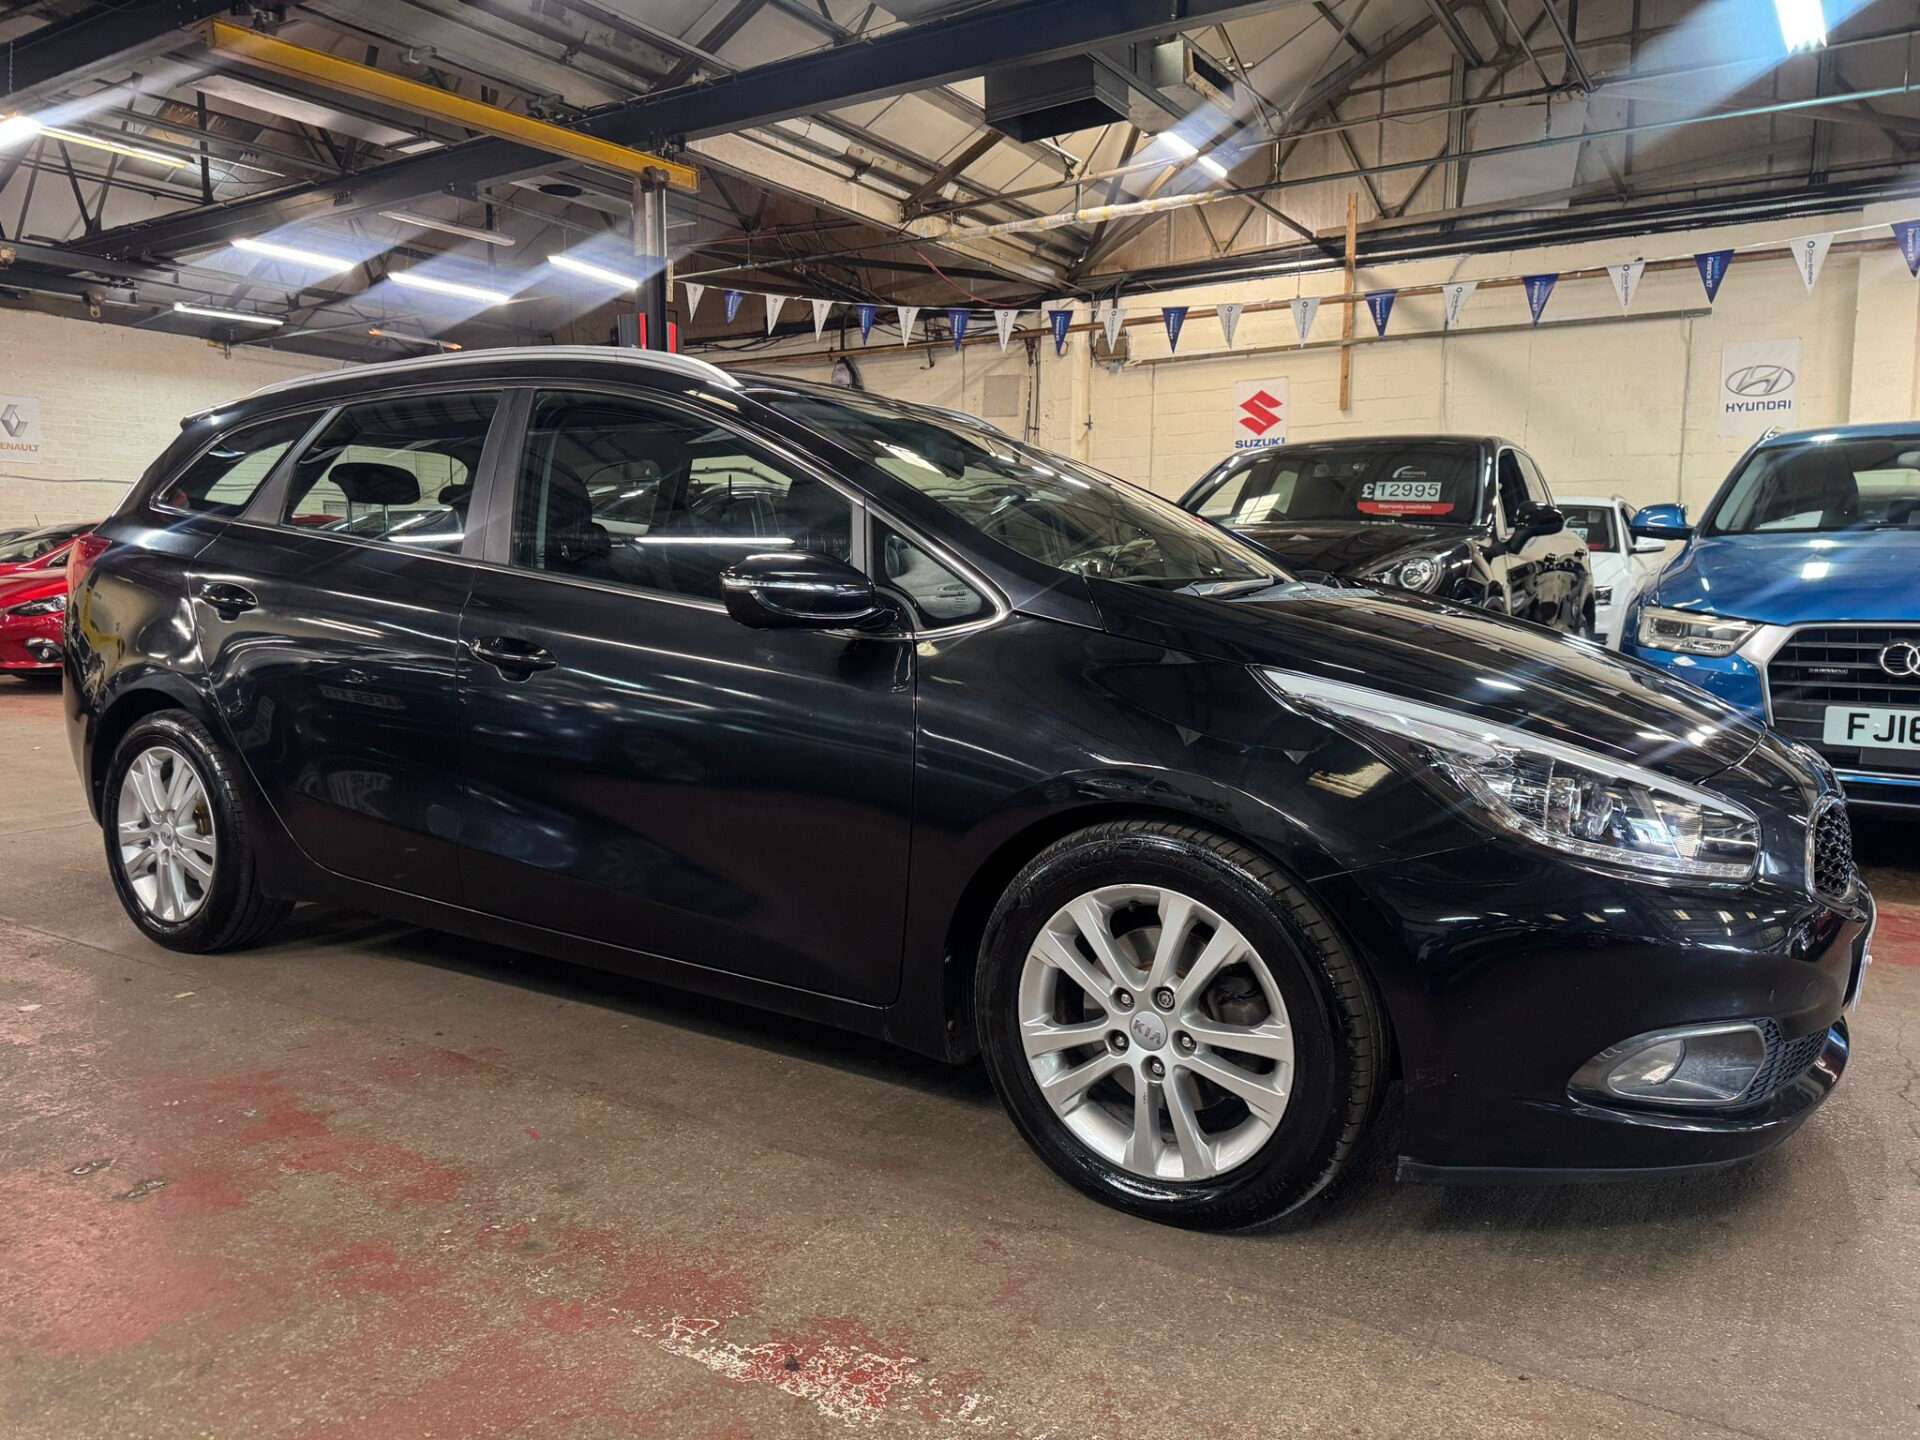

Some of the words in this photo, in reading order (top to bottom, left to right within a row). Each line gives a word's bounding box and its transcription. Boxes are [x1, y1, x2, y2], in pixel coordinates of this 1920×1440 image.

[1726, 400, 1791, 412] HYUNDAI
[0, 442, 40, 452] ENAULT
[1235, 437, 1285, 448] SUZUKI
[1361, 483, 1438, 498] £12995
[1133, 1019, 1161, 1045] KIA
